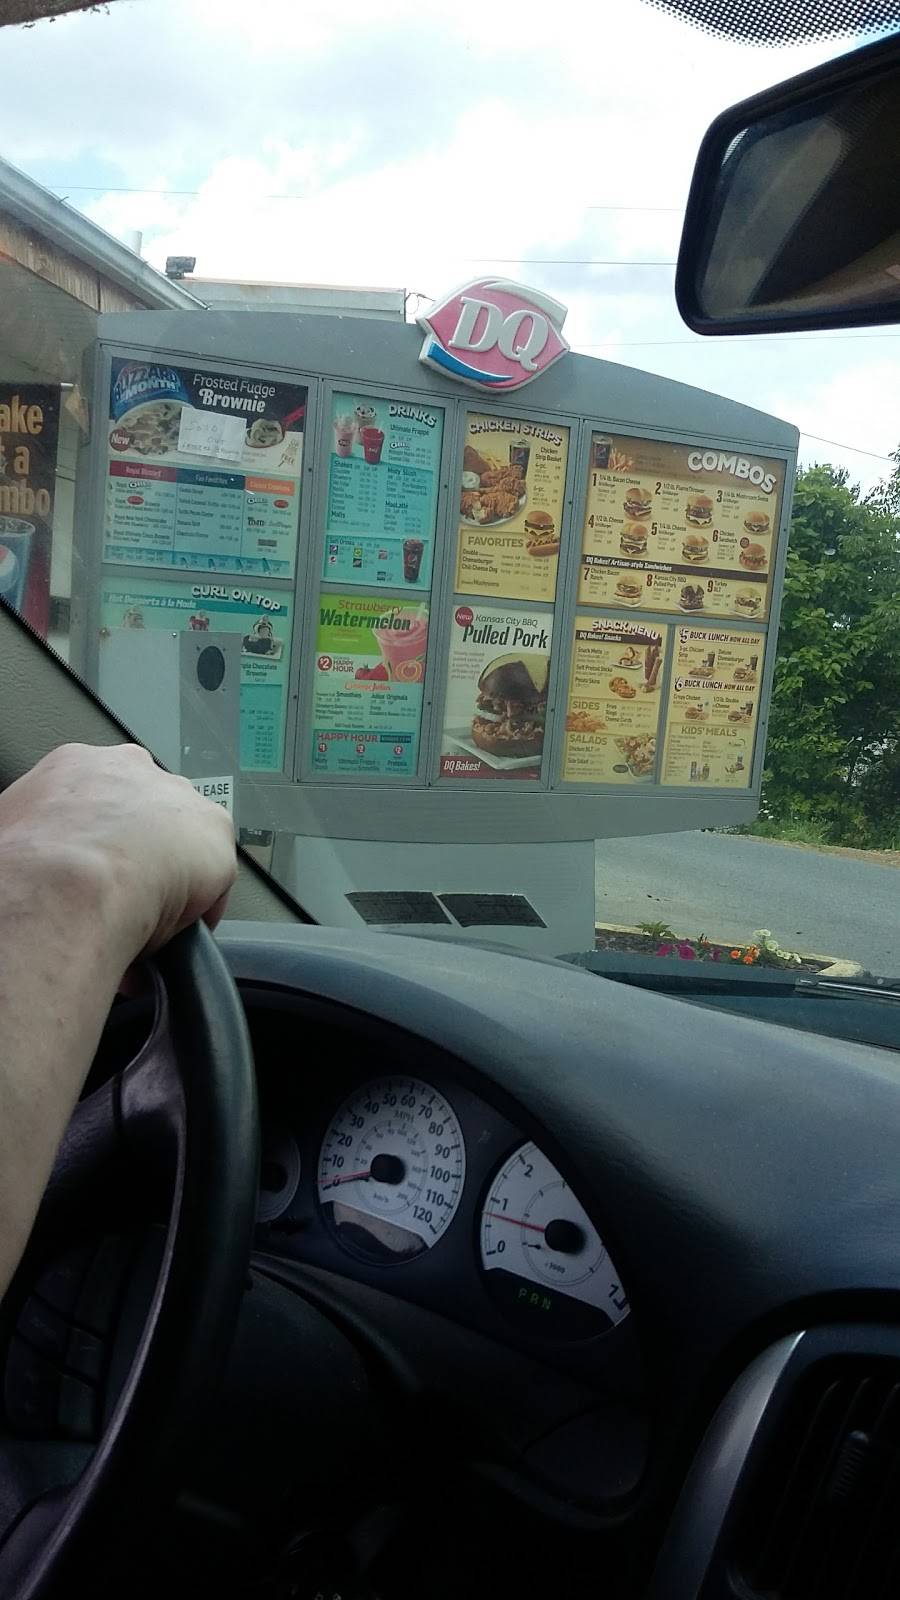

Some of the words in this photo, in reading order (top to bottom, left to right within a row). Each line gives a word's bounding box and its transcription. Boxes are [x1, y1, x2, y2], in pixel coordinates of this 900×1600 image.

[448, 297, 537, 372] DQ
[193, 373, 239, 392] Frosted
[240, 380, 276, 399] Fudge
[198, 388, 266, 413] Brownie
[389, 404, 437, 428] DRINKS
[111, 432, 130, 445] New
[469, 419, 520, 434] CHICKEN
[522, 424, 563, 446] STRIPS
[14, 446, 30, 475] a
[592, 472, 597, 487] 1
[687, 451, 777, 494] COMBOS
[655, 481, 662, 496] 2
[716, 490, 723, 503] 3
[588, 514, 595, 528] 4
[651, 522, 658, 536] 5
[712, 529, 719, 543] 6
[467, 535, 524, 548] FAVORITES
[584, 567, 591, 580] 7
[646, 573, 653, 587] 8
[707, 580, 714, 593] 9
[191, 584, 228, 601] CURL
[232, 587, 252, 604] ON
[255, 594, 281, 612] TOP
[338, 599, 402, 615] Strawberry
[320, 608, 411, 631] Watermelon
[475, 614, 505, 624] Kansas
[505, 617, 521, 626] City
[462, 624, 511, 646] Pulled
[512, 627, 549, 649] Pork
[592, 618, 627, 633] SNACK
[628, 621, 660, 641] MENU
[689, 631, 707, 640] BUCK
[707, 632, 730, 642] LUNCH
[684, 679, 701, 688] BUCK
[702, 680, 723, 690] LUNCH
[572, 700, 600, 711] SIDES
[317, 732, 349, 741] HAPPY
[351, 733, 378, 743] HOUR
[681, 726, 705, 735] KIDS'
[705, 727, 738, 737] MEALS
[569, 733, 608, 746] SALADS
[443, 760, 455, 773] DQ
[455, 760, 481, 772] Bakes!
[382, 1093, 397, 1106] 50
[401, 1094, 416, 1108] 60
[364, 1100, 380, 1114] 40
[418, 1104, 433, 1119] 70
[350, 1113, 364, 1129] 30
[428, 1121, 444, 1136] 80
[337, 1132, 353, 1147] 20
[434, 1144, 450, 1159] 90
[331, 1154, 345, 1168] 10
[429, 1165, 450, 1183] 100
[524, 1164, 534, 1178] 2
[425, 1189, 445, 1206] 110
[501, 1197, 508, 1211] 1
[412, 1205, 433, 1224] 120
[497, 1239, 506, 1253] 0
[608, 1283, 619, 1298] 7
[519, 1287, 528, 1299] P
[530, 1292, 539, 1305] R
[542, 1298, 552, 1311] N
